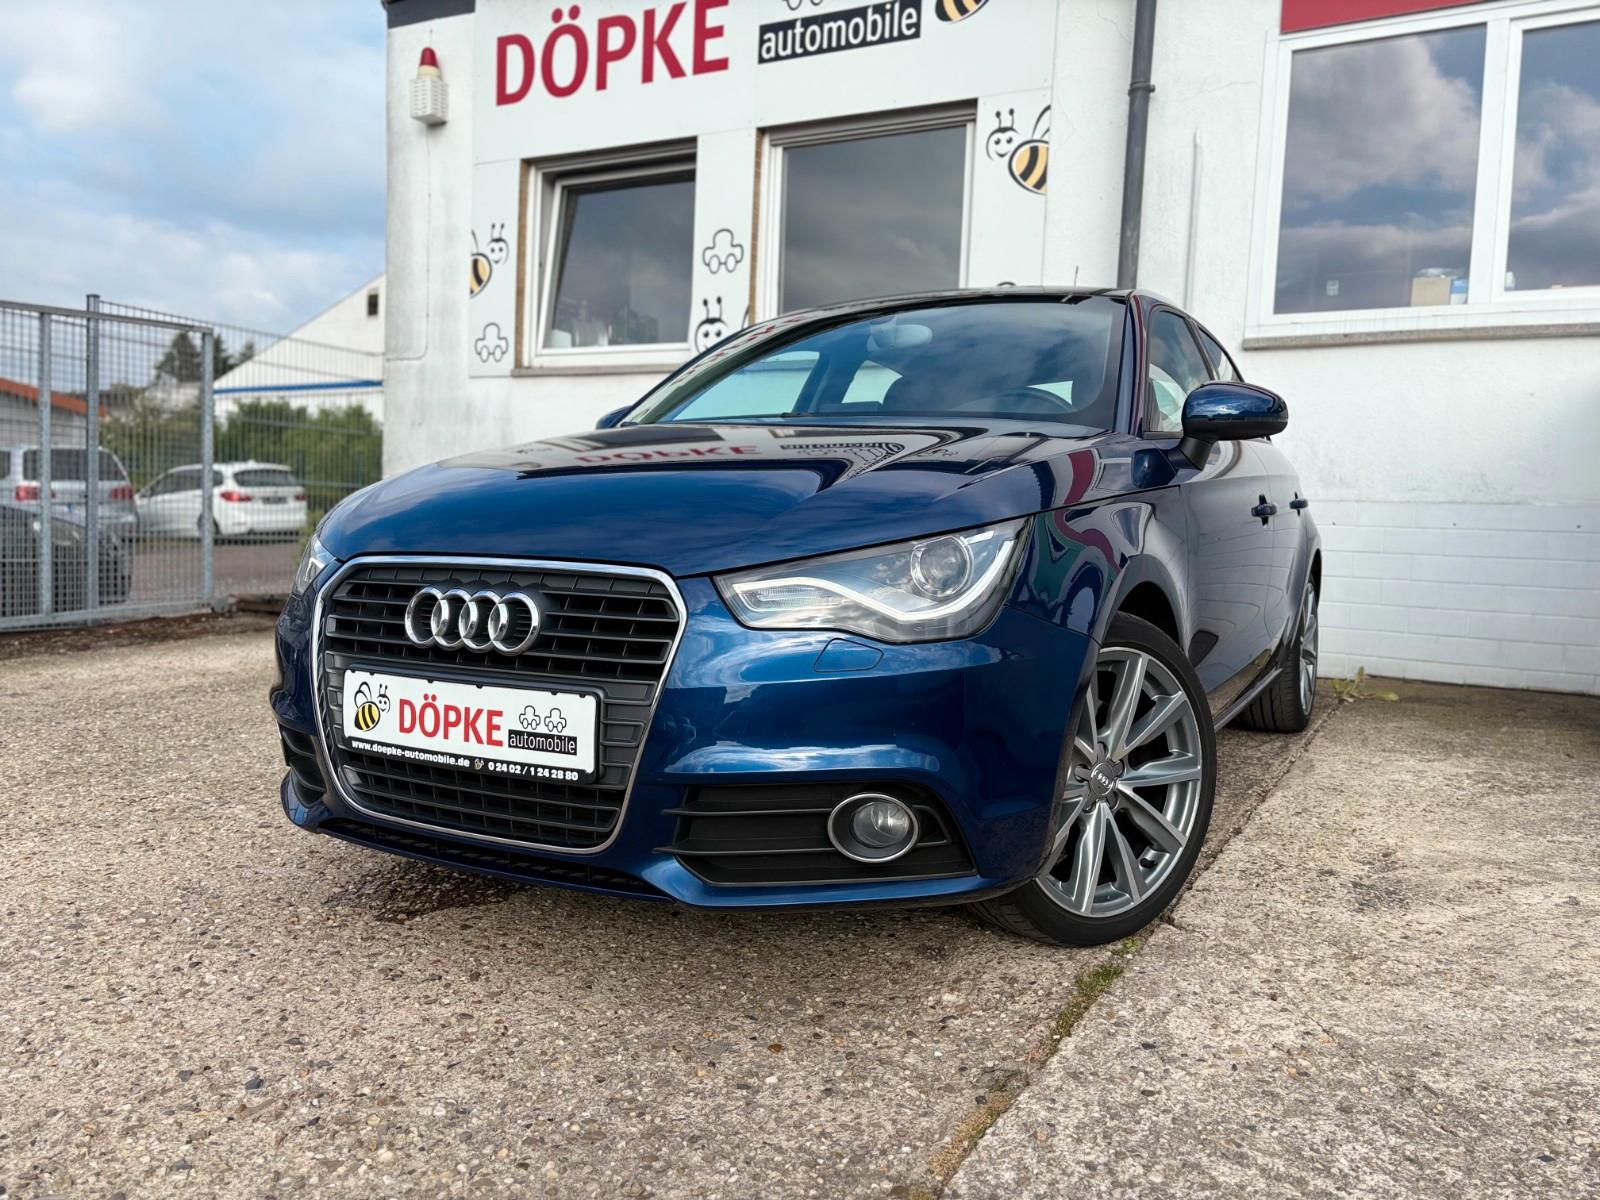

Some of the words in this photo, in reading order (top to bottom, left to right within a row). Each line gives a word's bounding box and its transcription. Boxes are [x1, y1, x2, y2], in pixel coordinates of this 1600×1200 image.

[496, 0, 729, 106] DÖPKE
[761, 3, 917, 60] automobile
[399, 693, 503, 747] DÖPKE
[509, 732, 576, 753] automobile
[352, 740, 470, 767] www.doepke-automobile.de
